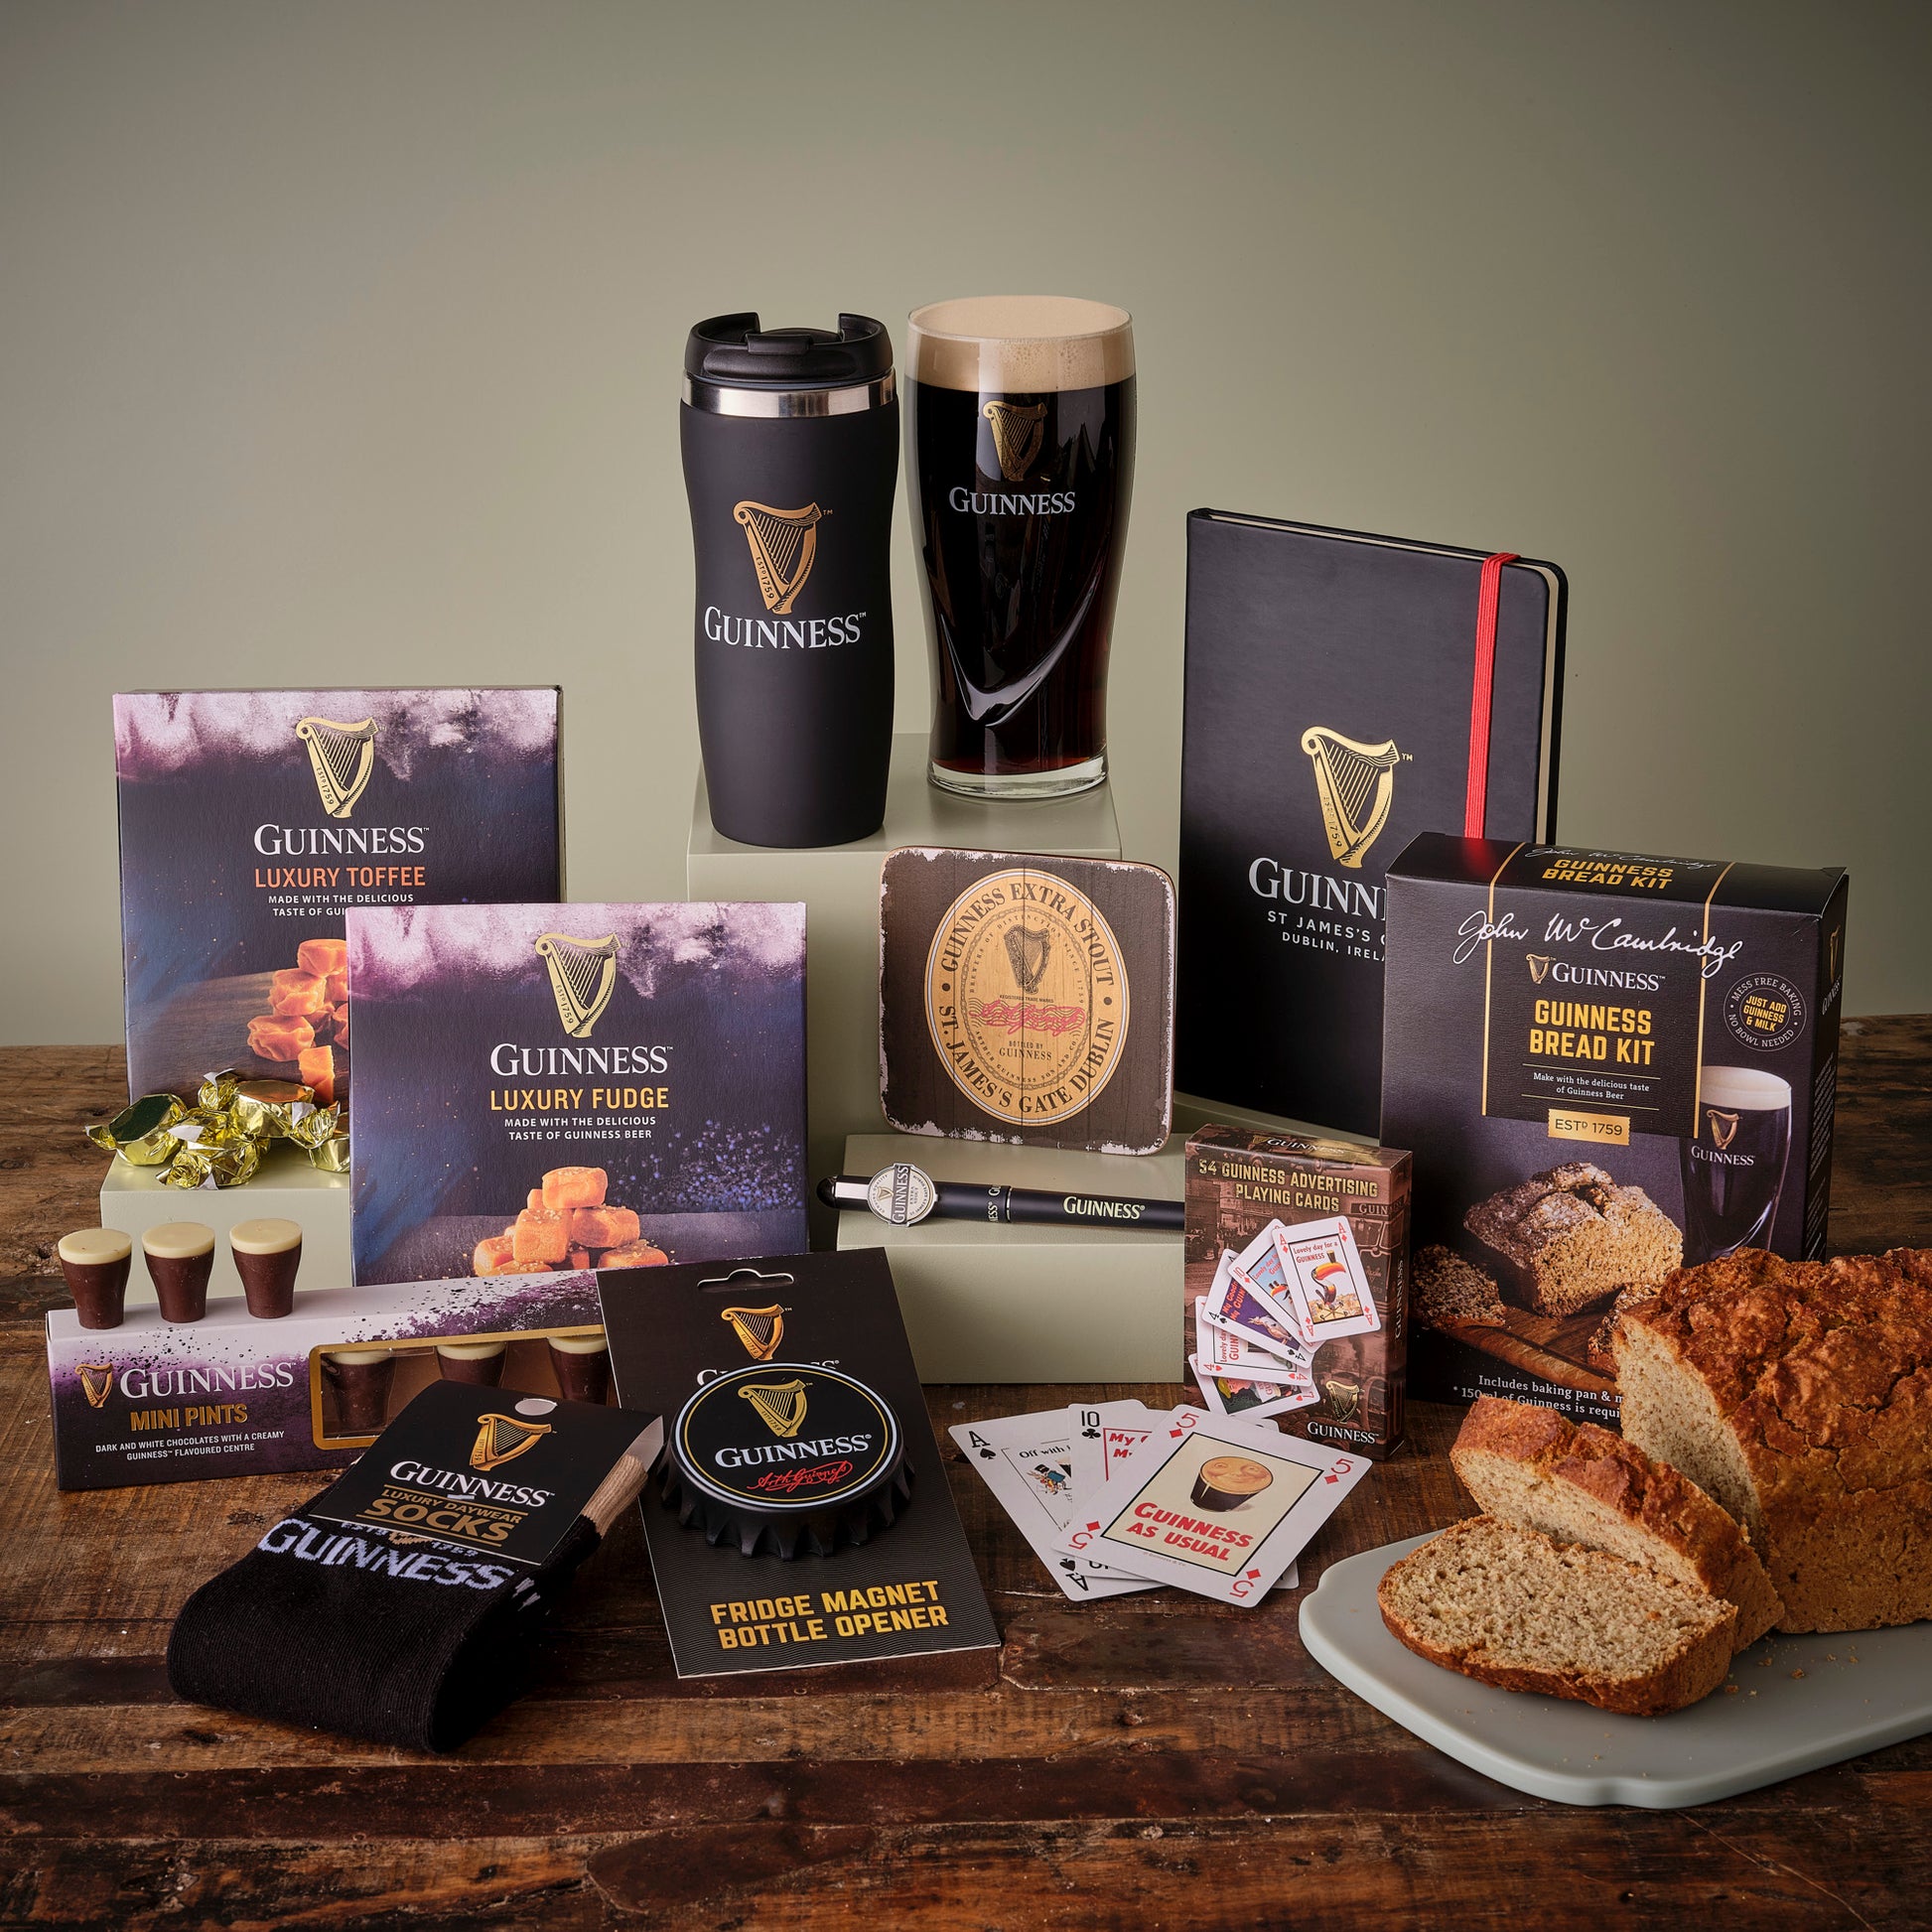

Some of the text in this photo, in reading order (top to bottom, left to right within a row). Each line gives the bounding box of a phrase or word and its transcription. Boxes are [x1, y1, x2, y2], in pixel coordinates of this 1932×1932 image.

[949, 486, 1075, 516] GUINNESS
[760, 576, 774, 600] 1759
[321, 784, 335, 805] 1759
[254, 866, 426, 888] LUXURY TOFFEE
[1541, 868, 1673, 890] BREAD KIT
[1554, 859, 1674, 878] GUINNESS
[268, 894, 414, 903] MADE WITH THE DELICIOUS
[273, 907, 305, 916] TASTE
[309, 907, 323, 916] OF
[940, 882, 1116, 986] GUINNESS EXTRA STOUT
[1267, 909, 1288, 925] ST
[1297, 916, 1371, 942] JAMES'S
[1452, 909, 1529, 964] John
[1282, 931, 1339, 954] DUBLIN,
[1731, 980, 1753, 1002] MESS
[1754, 977, 1779, 988] FREE
[1779, 983, 1802, 1017] BAKING
[1745, 995, 1787, 1014] JUST ADD
[560, 1003, 574, 1025] 1759
[938, 1005, 959, 1035] ST.
[1535, 999, 1652, 1035] GUINNESS
[1743, 1005, 1785, 1024] GUINNESS
[1746, 1016, 1777, 1033] & MILK
[1728, 1013, 1794, 1047] NO BOWL NEEDED
[999, 1047, 1052, 1060] GUINNESS
[1069, 1019, 1115, 1093] DUBLIN
[1529, 1029, 1655, 1065] BREAD KIT
[945, 1039, 1014, 1108] JAMES'S
[1533, 1072, 1650, 1092] Make with the delicious taste
[490, 1087, 669, 1111] LUXURY FUDGE
[1019, 1085, 1073, 1113] GATE
[1567, 1086, 1603, 1098] Guinness
[1605, 1090, 1625, 1100] Beer
[504, 1116, 656, 1128] MADE WITH THE DELICIOUS
[1592, 1122, 1623, 1136] 1759
[509, 1130, 652, 1141] TASTE OF GUINNESS BEER
[1691, 1145, 1755, 1167] GUINNESS
[1198, 1159, 1378, 1197] 54 GUINNESS ADVERTISING
[893, 1166, 909, 1223] GUINNESS
[1235, 1183, 1340, 1213] PLAYING CARDS
[1337, 1222, 1346, 1234] A
[1279, 1233, 1288, 1246] A
[1293, 1245, 1311, 1255] Lovely
[1296, 1252, 1325, 1263] GUINNESS
[1233, 1266, 1245, 1279] 10
[1208, 1311, 1220, 1320] 4
[1478, 1375, 1529, 1391] Includes
[1532, 1381, 1573, 1400] baking
[1576, 1389, 1597, 1402] pan
[1601, 1390, 1611, 1402] &
[1517, 1395, 1572, 1412] Guinness
[1576, 1402, 1586, 1414] is
[129, 1403, 248, 1432] MINI PINTS
[1080, 1410, 1100, 1428] 10
[1175, 1413, 1200, 1430] 5
[95, 1430, 285, 1453] DARK AND WHITE CHOCOLATES WITH A CREAMY
[175, 1446, 223, 1457] FLAVOURED
[223, 1443, 255, 1453] CENTRE
[968, 1431, 990, 1449] A
[1109, 1433, 1136, 1447] My
[1019, 1446, 1065, 1458] Off with
[1330, 1457, 1354, 1475] 5
[381, 1488, 522, 1526] LUXURY DAYWEAR
[364, 1498, 517, 1543] SOCKS
[1134, 1501, 1255, 1549] GUINNESS
[1068, 1532, 1093, 1550] 5
[1126, 1522, 1160, 1539] AS
[1165, 1531, 1231, 1562] USUAL
[257, 1517, 516, 1590] GUINNESS
[1229, 1580, 1255, 1598] 5
[710, 1580, 939, 1625] FRIDGE MAGNET
[718, 1604, 949, 1650] BOTTLE OPENER
